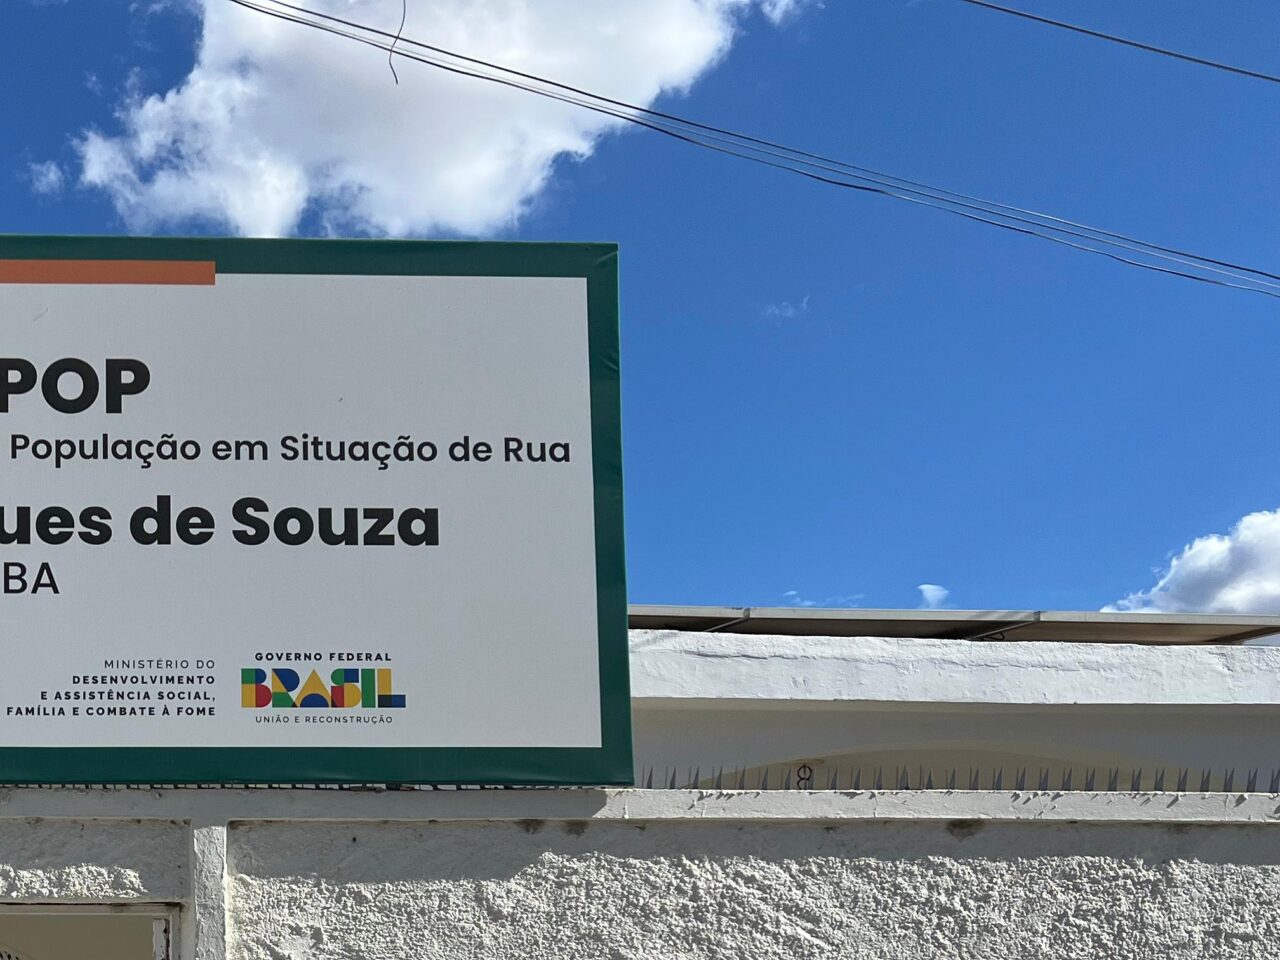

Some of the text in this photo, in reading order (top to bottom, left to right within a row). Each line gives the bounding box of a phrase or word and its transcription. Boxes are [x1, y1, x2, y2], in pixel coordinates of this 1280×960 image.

[10, 433, 201, 469] População
[211, 439, 269, 461] em
[280, 433, 438, 470] Situação
[448, 436, 493, 462] de
[503, 436, 571, 463] Rua
[129, 495, 216, 546] de
[231, 496, 440, 547] Souza
[255, 652, 392, 661] GOVERNO FEDERAL
[104, 658, 215, 669] MINISTÉRIO DO
[72, 675, 216, 685] DESENVOLVIMENTO
[241, 668, 406, 708] BRASIL
[41, 689, 216, 702] E ASSISTÊNCIA SOCIAL,
[6, 704, 216, 716] FAMÍLIA E COMBATE À FOME
[255, 714, 393, 725] UNIÃO E RECONSTRUÇÃO
